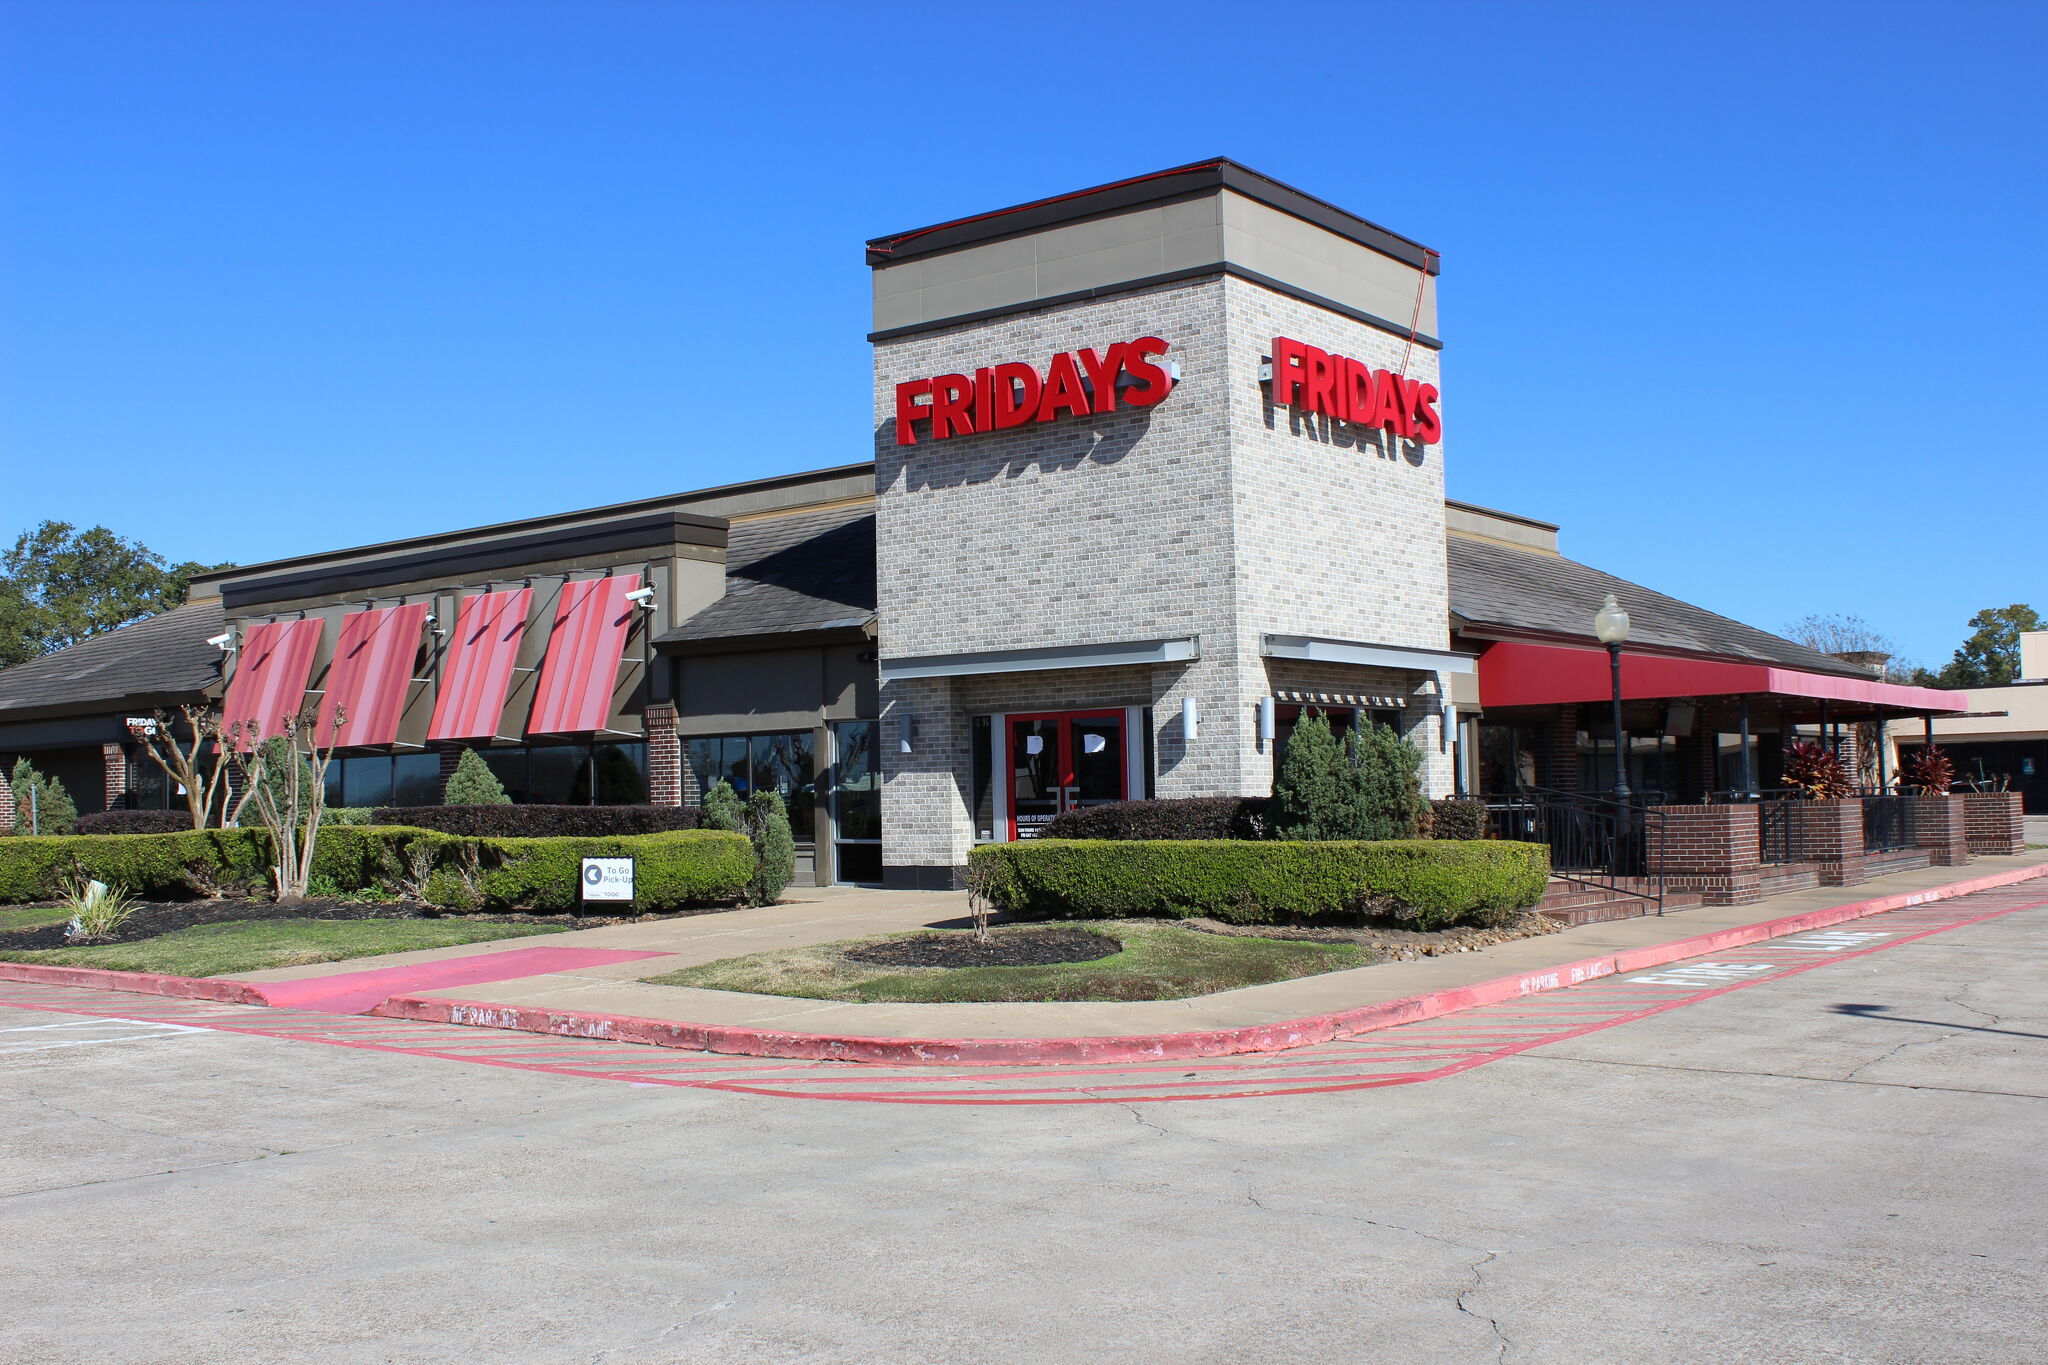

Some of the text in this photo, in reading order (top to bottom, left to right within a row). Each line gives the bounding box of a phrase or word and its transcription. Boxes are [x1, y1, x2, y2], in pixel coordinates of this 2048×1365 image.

[896, 336, 1174, 445] FRIDAYS
[1272, 336, 1441, 445] FRIDAYS
[126, 717, 156, 726] FRIDAY
[603, 876, 634, 884] Pick-Up
[1624, 931, 1893, 987] FIRE LANE
[1531, 972, 1559, 990] PARKING
